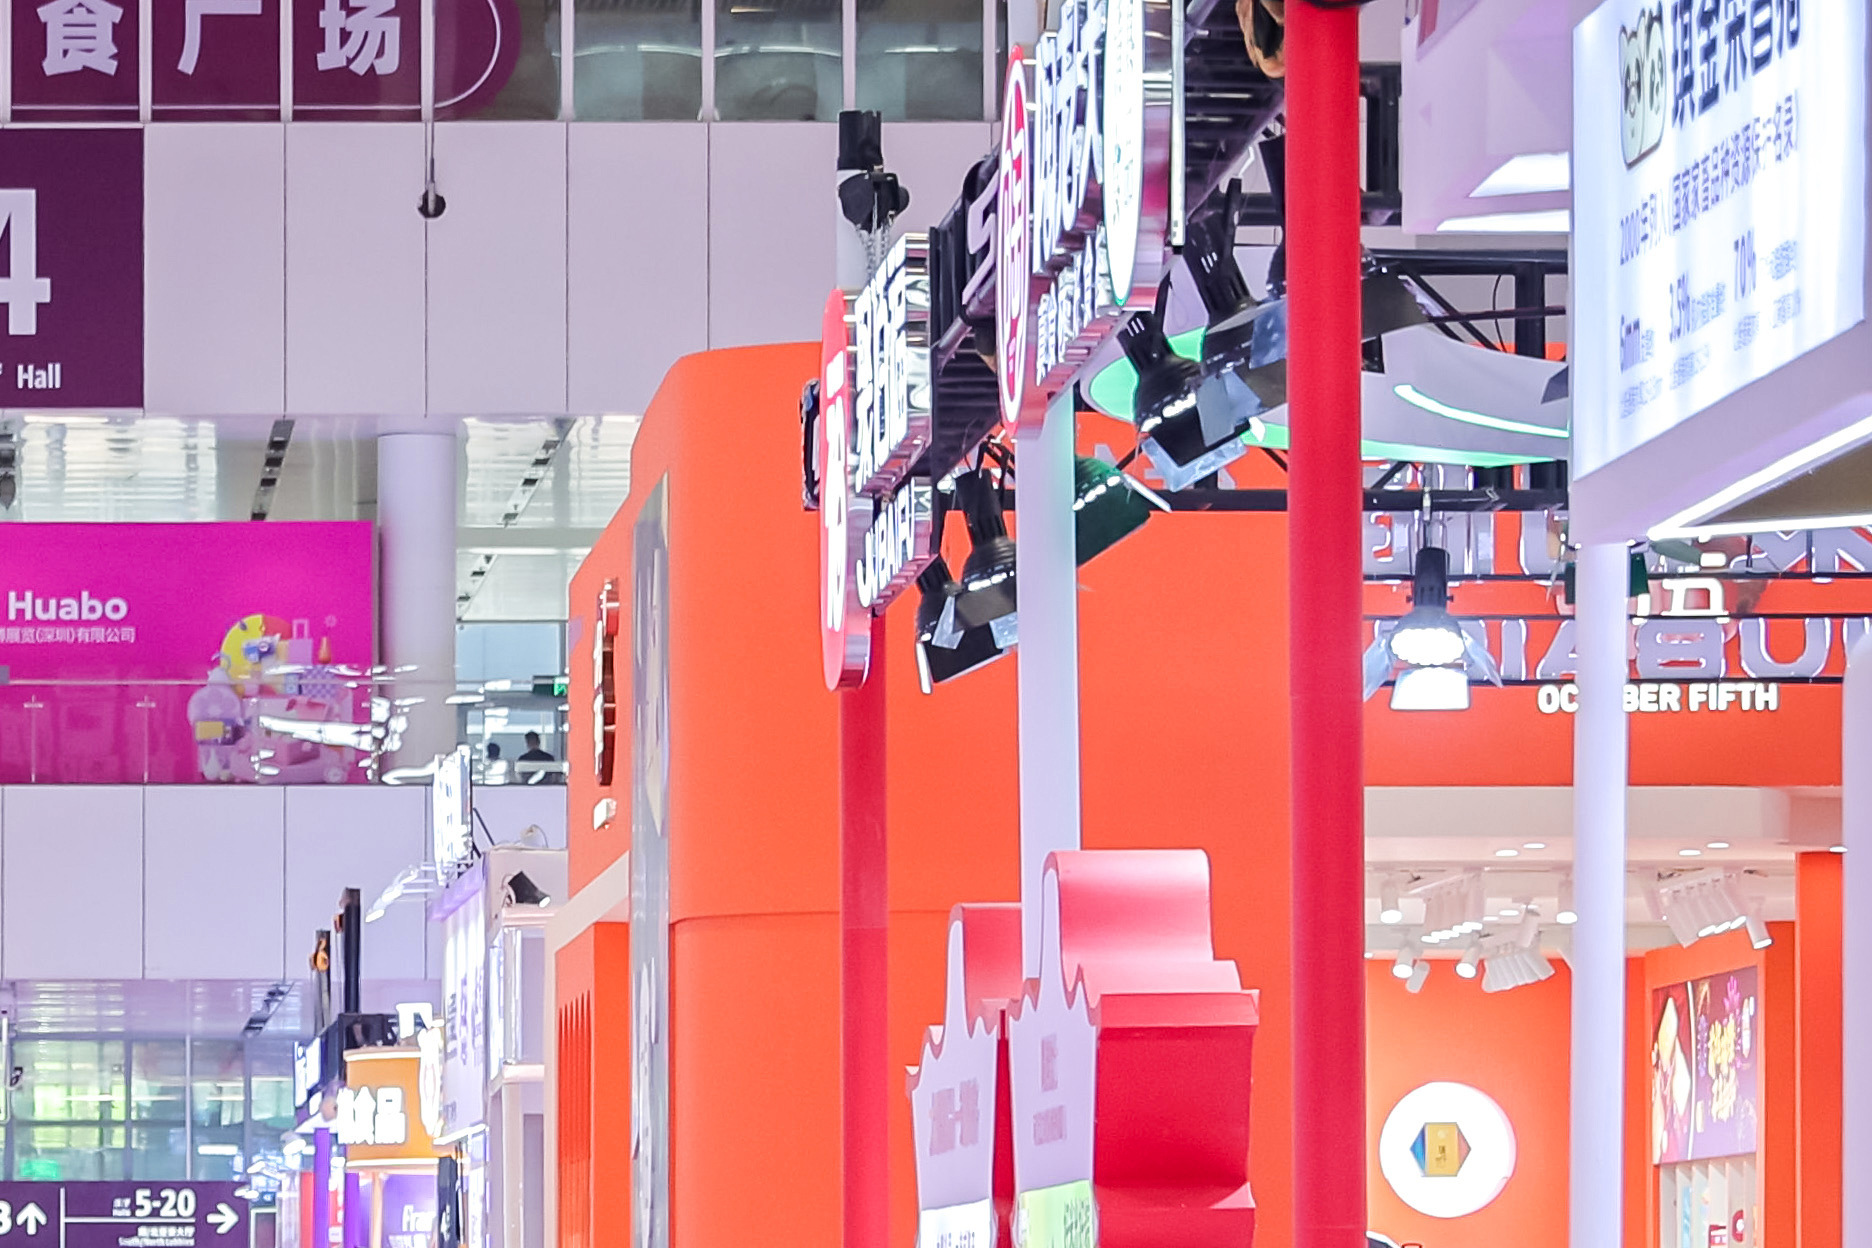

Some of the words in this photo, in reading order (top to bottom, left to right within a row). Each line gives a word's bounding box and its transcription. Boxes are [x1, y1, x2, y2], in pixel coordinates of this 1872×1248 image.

[17, 363, 62, 391] Hall
[8, 591, 128, 621] Huabo
[1538, 682, 1680, 714] OCBER
[1688, 682, 1780, 712] FIFTH
[135, 1188, 196, 1218] 5-20
